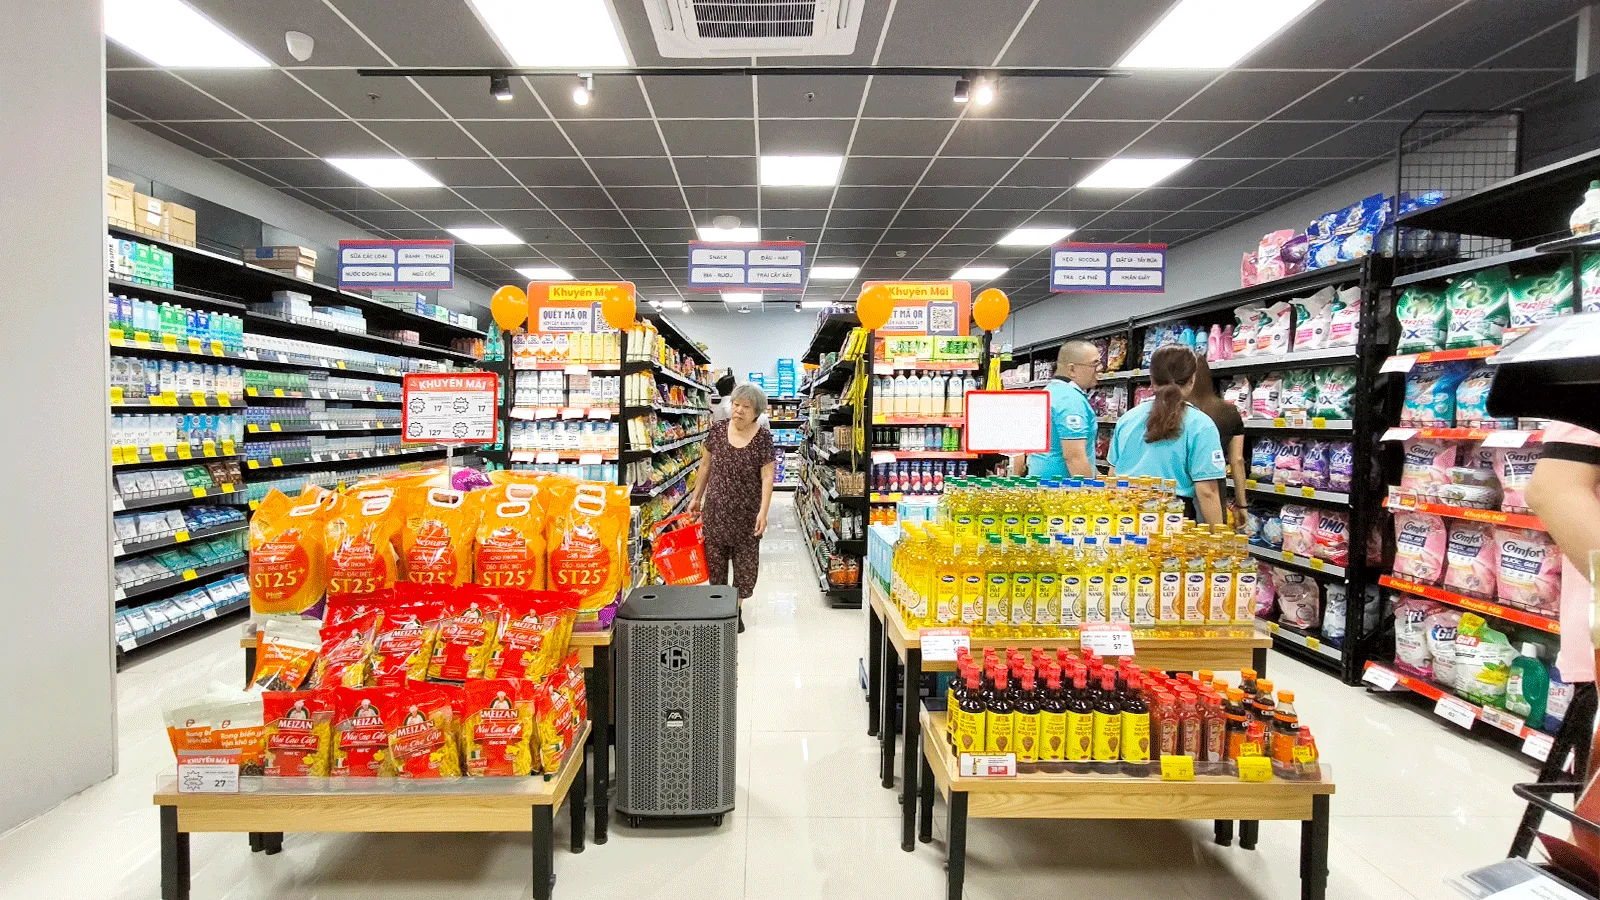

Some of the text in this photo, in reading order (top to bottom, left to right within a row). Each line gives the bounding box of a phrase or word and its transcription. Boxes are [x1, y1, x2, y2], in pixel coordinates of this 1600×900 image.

[553, 287, 592, 299] Khuyến
[889, 287, 928, 298] Khuyến
[1516, 299, 1552, 310] ARIEL
[544, 309, 562, 320] QUÉT
[564, 308, 576, 320] MÃ
[900, 308, 911, 318] MÃ
[913, 310, 923, 318] QR
[419, 377, 462, 390] KHUYẾN
[1281, 446, 1300, 456] OMO
[1410, 444, 1437, 456] Comfo
[1504, 450, 1542, 462] Comfo
[1464, 510, 1492, 520] Khuyến
[1319, 518, 1345, 534] OMO
[1404, 521, 1432, 534] Comfort
[1452, 531, 1483, 544] Comfort
[1502, 540, 1546, 558] Comfort
[1460, 598, 1488, 611] Khuyến
[454, 616, 484, 624] MEIZAN
[512, 621, 544, 630] MEIZAN
[392, 629, 422, 637] MEIZAN
[1436, 628, 1457, 639] Gif
[1456, 636, 1478, 646] Gift
[1548, 687, 1566, 696] Gift
[481, 710, 518, 718] MEIZAN
[278, 719, 312, 730] MEIZAN
[352, 716, 383, 726] MEIZAN
[240, 730, 256, 738] biển
[397, 721, 434, 737] MEIZAN
[476, 725, 489, 733] Nui
[490, 725, 505, 733] Cao
[270, 734, 317, 745] Nui Cao Cấp
[187, 756, 216, 764] KHUYẾN
